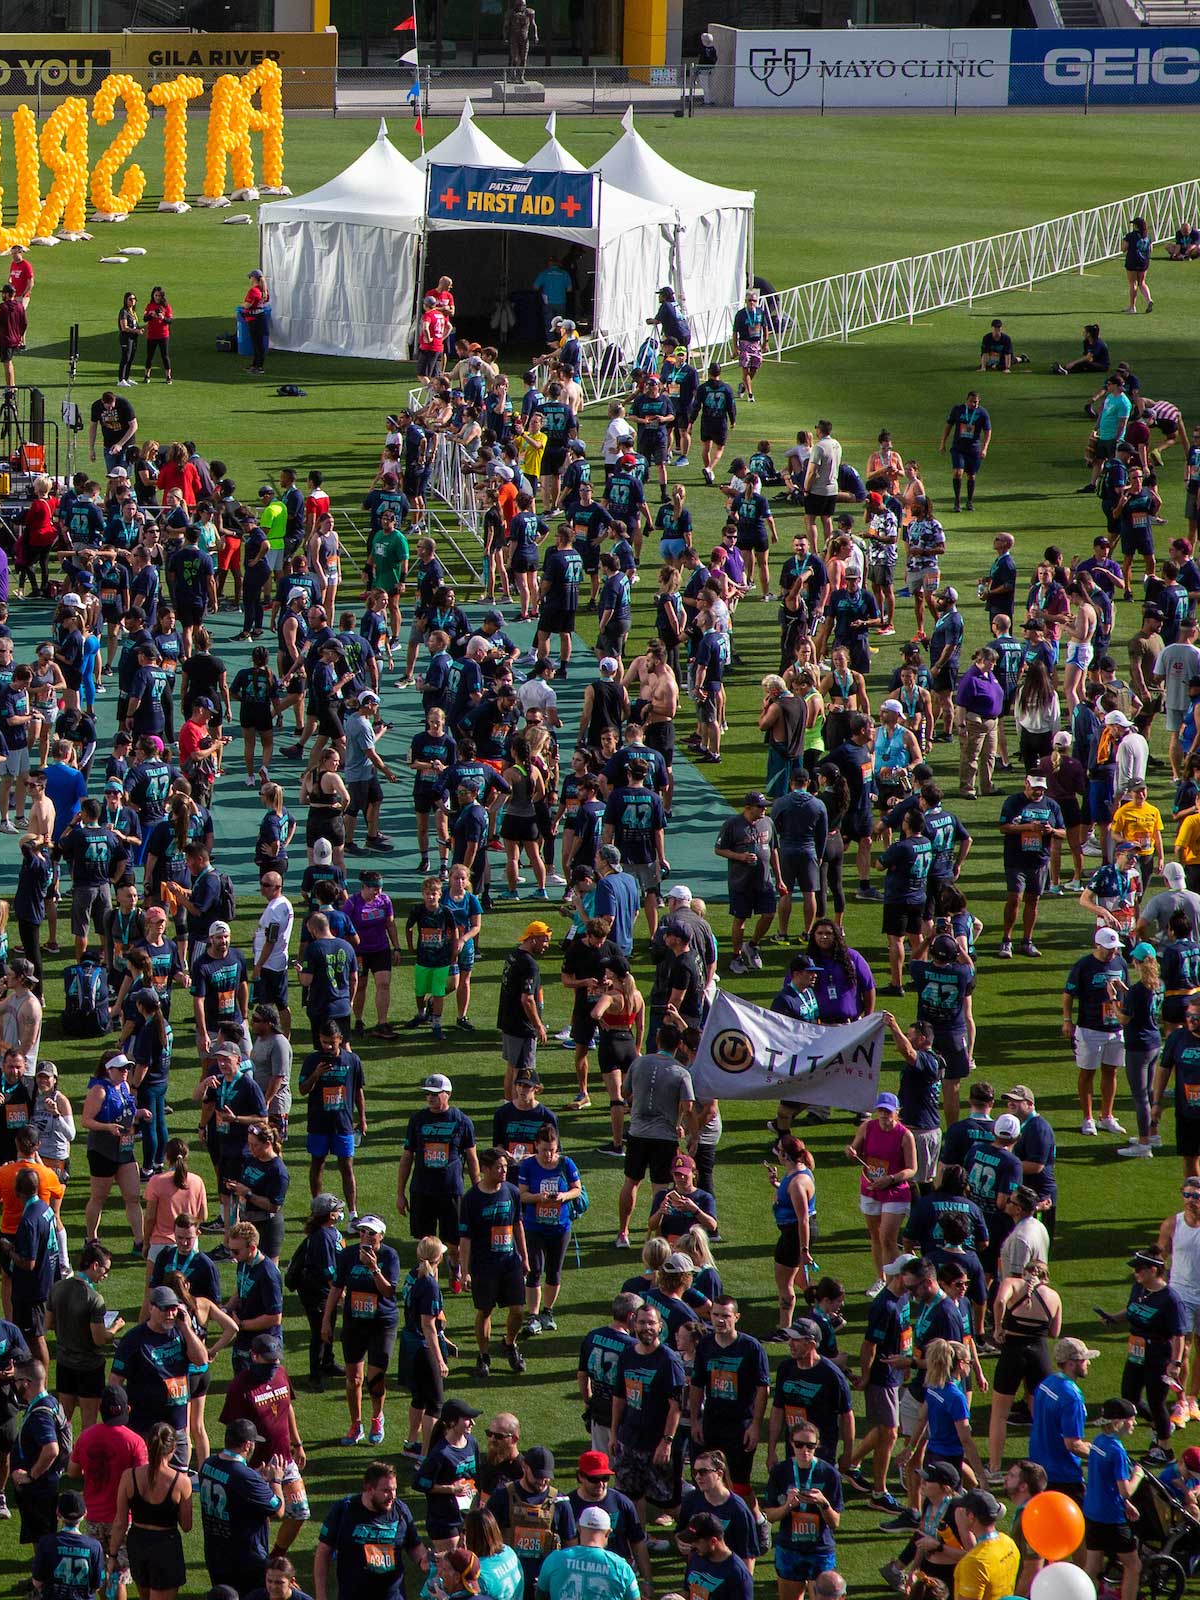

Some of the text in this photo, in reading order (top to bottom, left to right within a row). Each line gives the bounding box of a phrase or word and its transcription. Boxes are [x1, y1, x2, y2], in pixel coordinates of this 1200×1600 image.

[148, 49, 281, 66] GILA RIVER
[18, 59, 93, 87] YOU
[819, 59, 994, 78] MAYO CLINIC
[488, 183, 531, 192] PAT'S RUN
[467, 191, 554, 215] FIRST AID
[610, 485, 630, 505] 42
[70, 515, 89, 533] 42
[566, 562, 582, 583] 42
[146, 776, 169, 800] 42
[622, 805, 650, 829] 42
[934, 827, 954, 850] 42
[85, 843, 108, 862] 42
[912, 852, 932, 878] 42
[925, 971, 958, 982] TILLMAN
[921, 983, 958, 1008] 42
[765, 1041, 875, 1076] TITAN
[426, 1151, 446, 1161] 5443
[540, 1183, 558, 1192] RUN
[968, 1169, 996, 1198] 42
[592, 1336, 625, 1350] TILLMAN
[587, 1346, 620, 1387] 42
[274, 1386, 288, 1396] STATE
[201, 1481, 229, 1521] 42
[794, 1524, 816, 1534] 1010
[518, 1538, 540, 1550] 4235
[54, 1557, 90, 1585] 42
[567, 1558, 610, 1574] TILLMAN
[560, 1574, 610, 1600] 42
